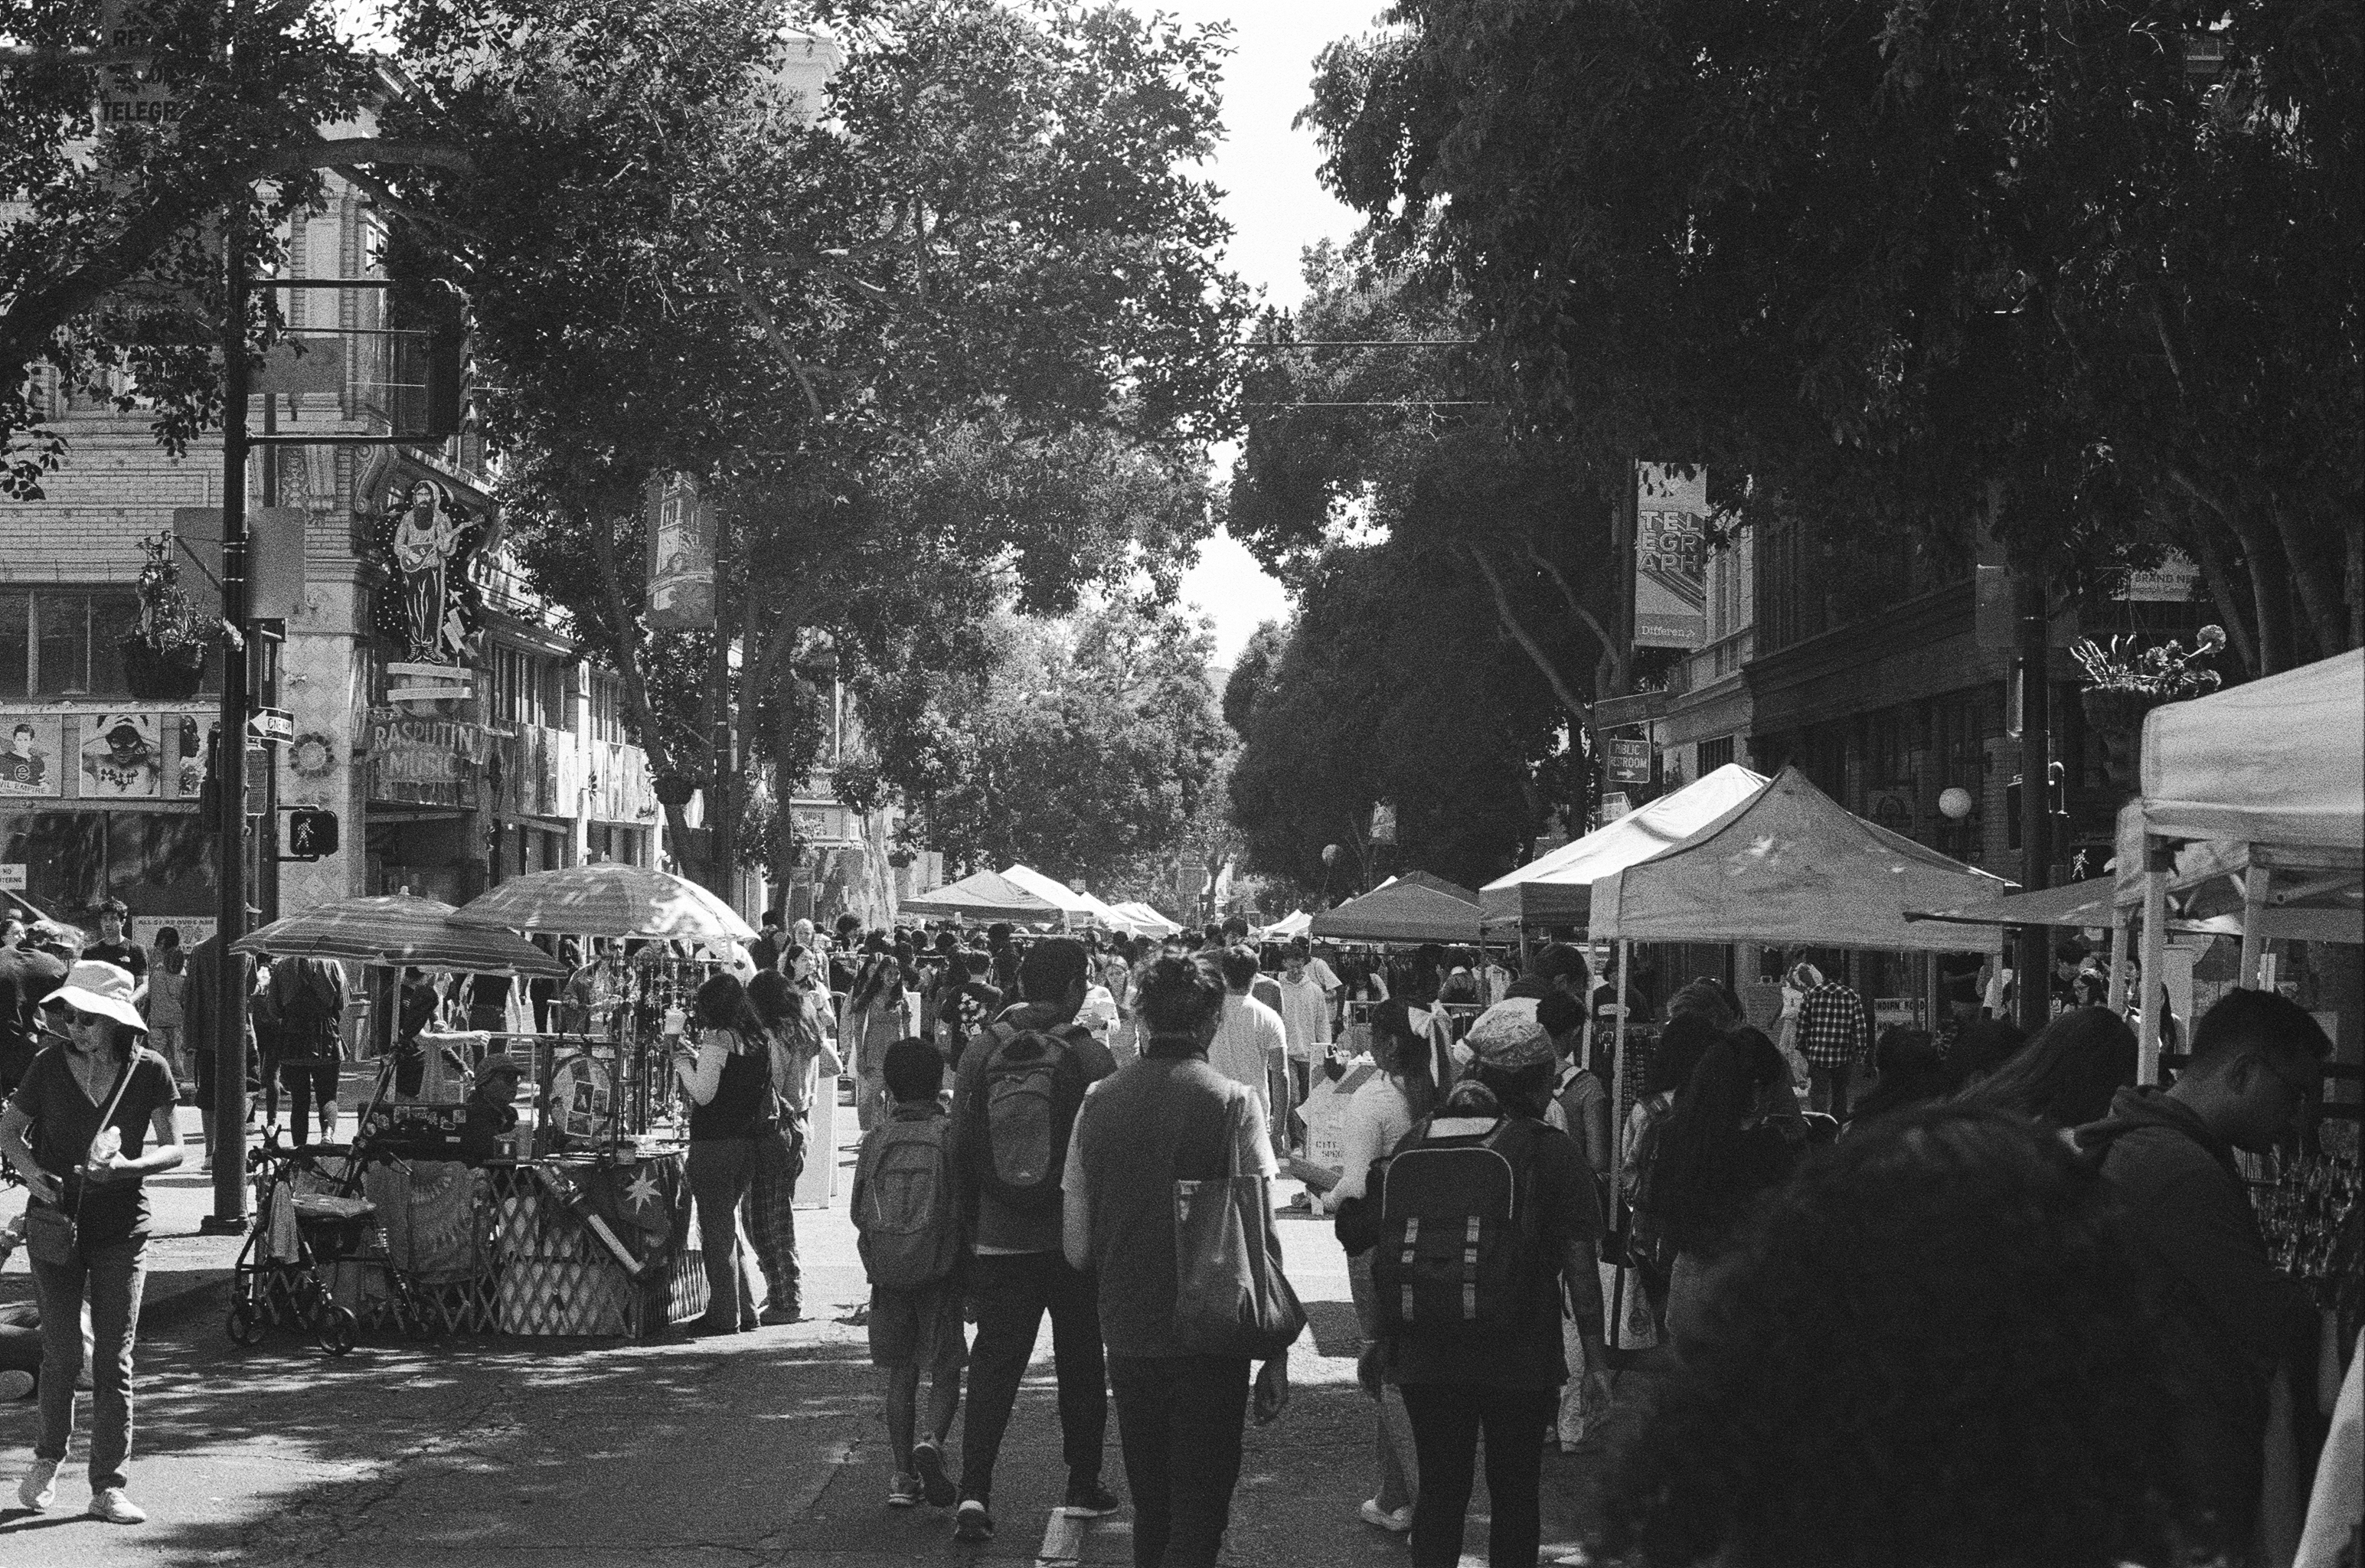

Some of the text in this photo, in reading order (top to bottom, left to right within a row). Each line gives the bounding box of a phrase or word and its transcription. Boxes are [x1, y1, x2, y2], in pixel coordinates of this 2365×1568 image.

[103, 100, 178, 122] TELEGR
[1641, 511, 1700, 531] TEL
[1641, 533, 1698, 552] EGR
[1638, 554, 1697, 573] APH
[374, 721, 474, 752] RASPUTIN
[1615, 743, 1640, 756] PUBLIC
[389, 750, 458, 777] MUSIC
[1609, 756, 1648, 769] RESTROOM
[14, 783, 47, 794] EMPIRE
[1875, 1001, 1925, 1011] INDIAN FOD
